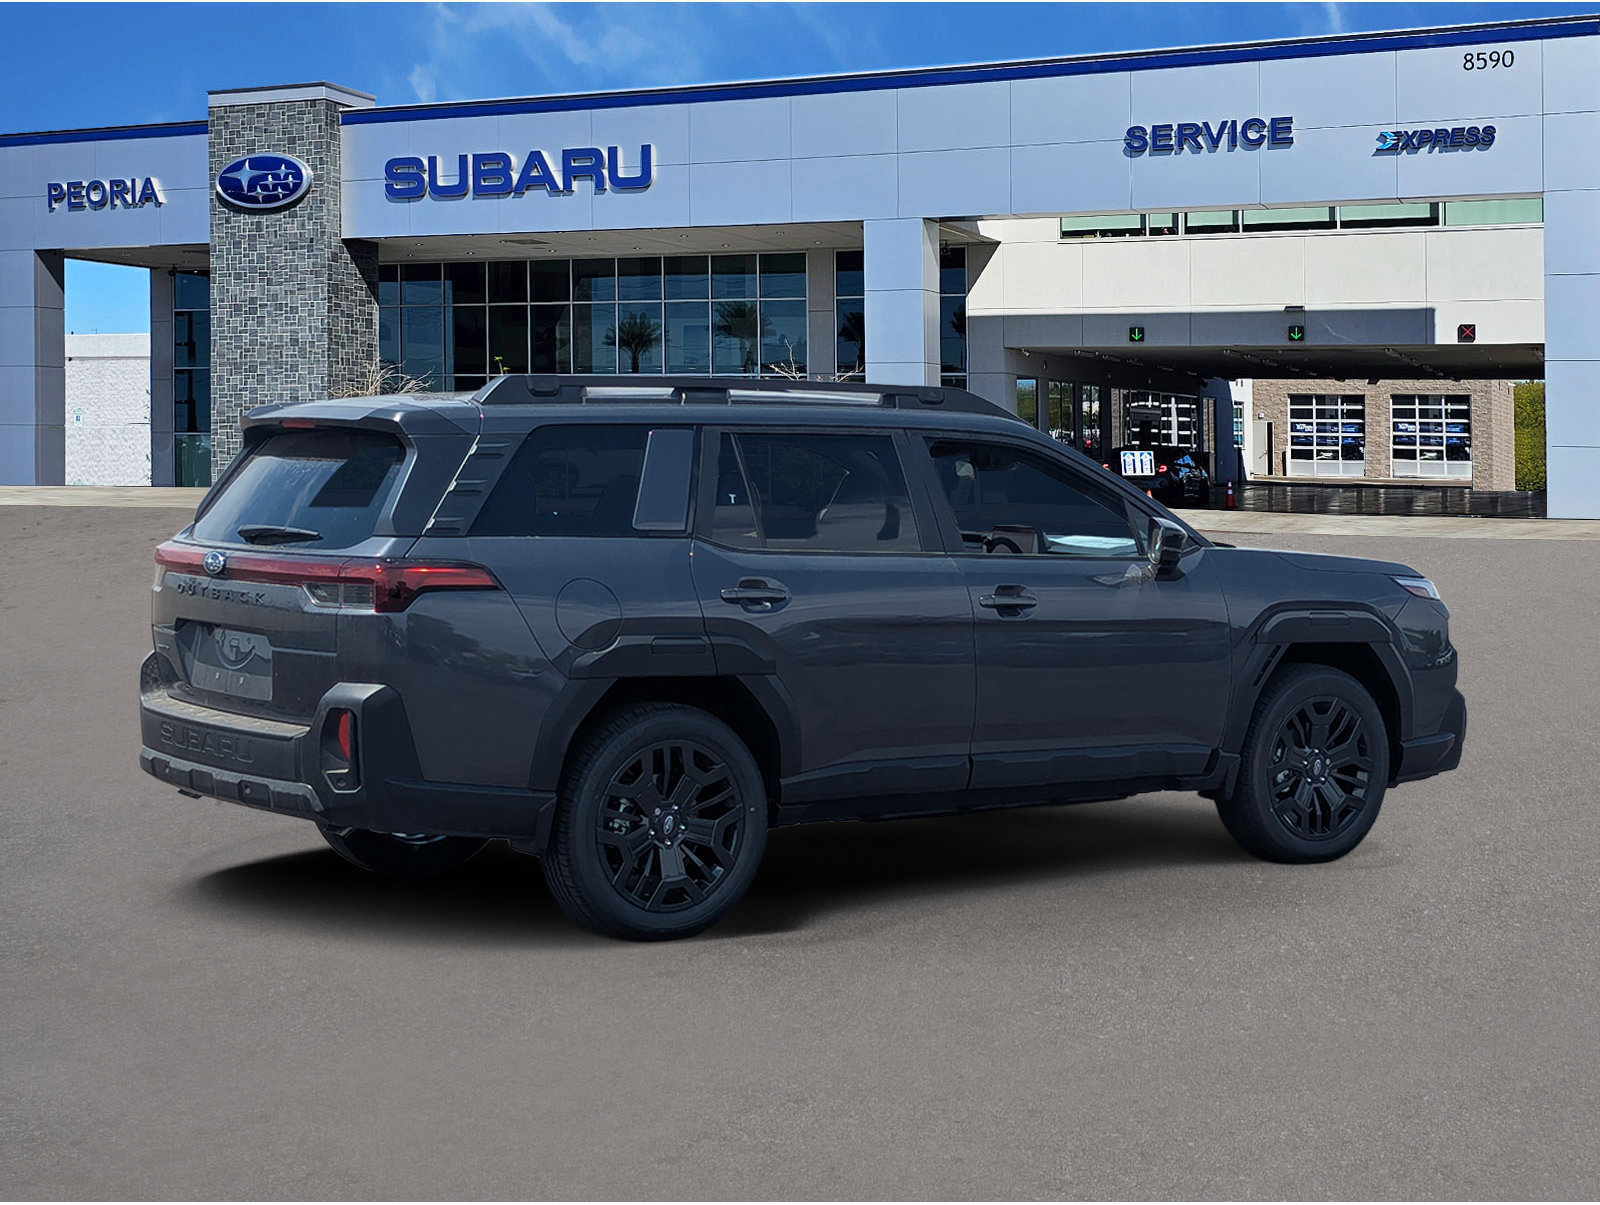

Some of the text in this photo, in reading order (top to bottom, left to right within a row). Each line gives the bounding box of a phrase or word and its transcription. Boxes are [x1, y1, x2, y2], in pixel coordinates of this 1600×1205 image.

[1463, 50, 1515, 71] 8590
[1125, 116, 1294, 152] SERVICE
[1375, 125, 1496, 152] EXPRESS
[384, 144, 653, 200] SUBARU
[47, 177, 164, 212] PEORIA
[177, 582, 266, 605] OUTBACK
[160, 721, 255, 764] SUBARU
